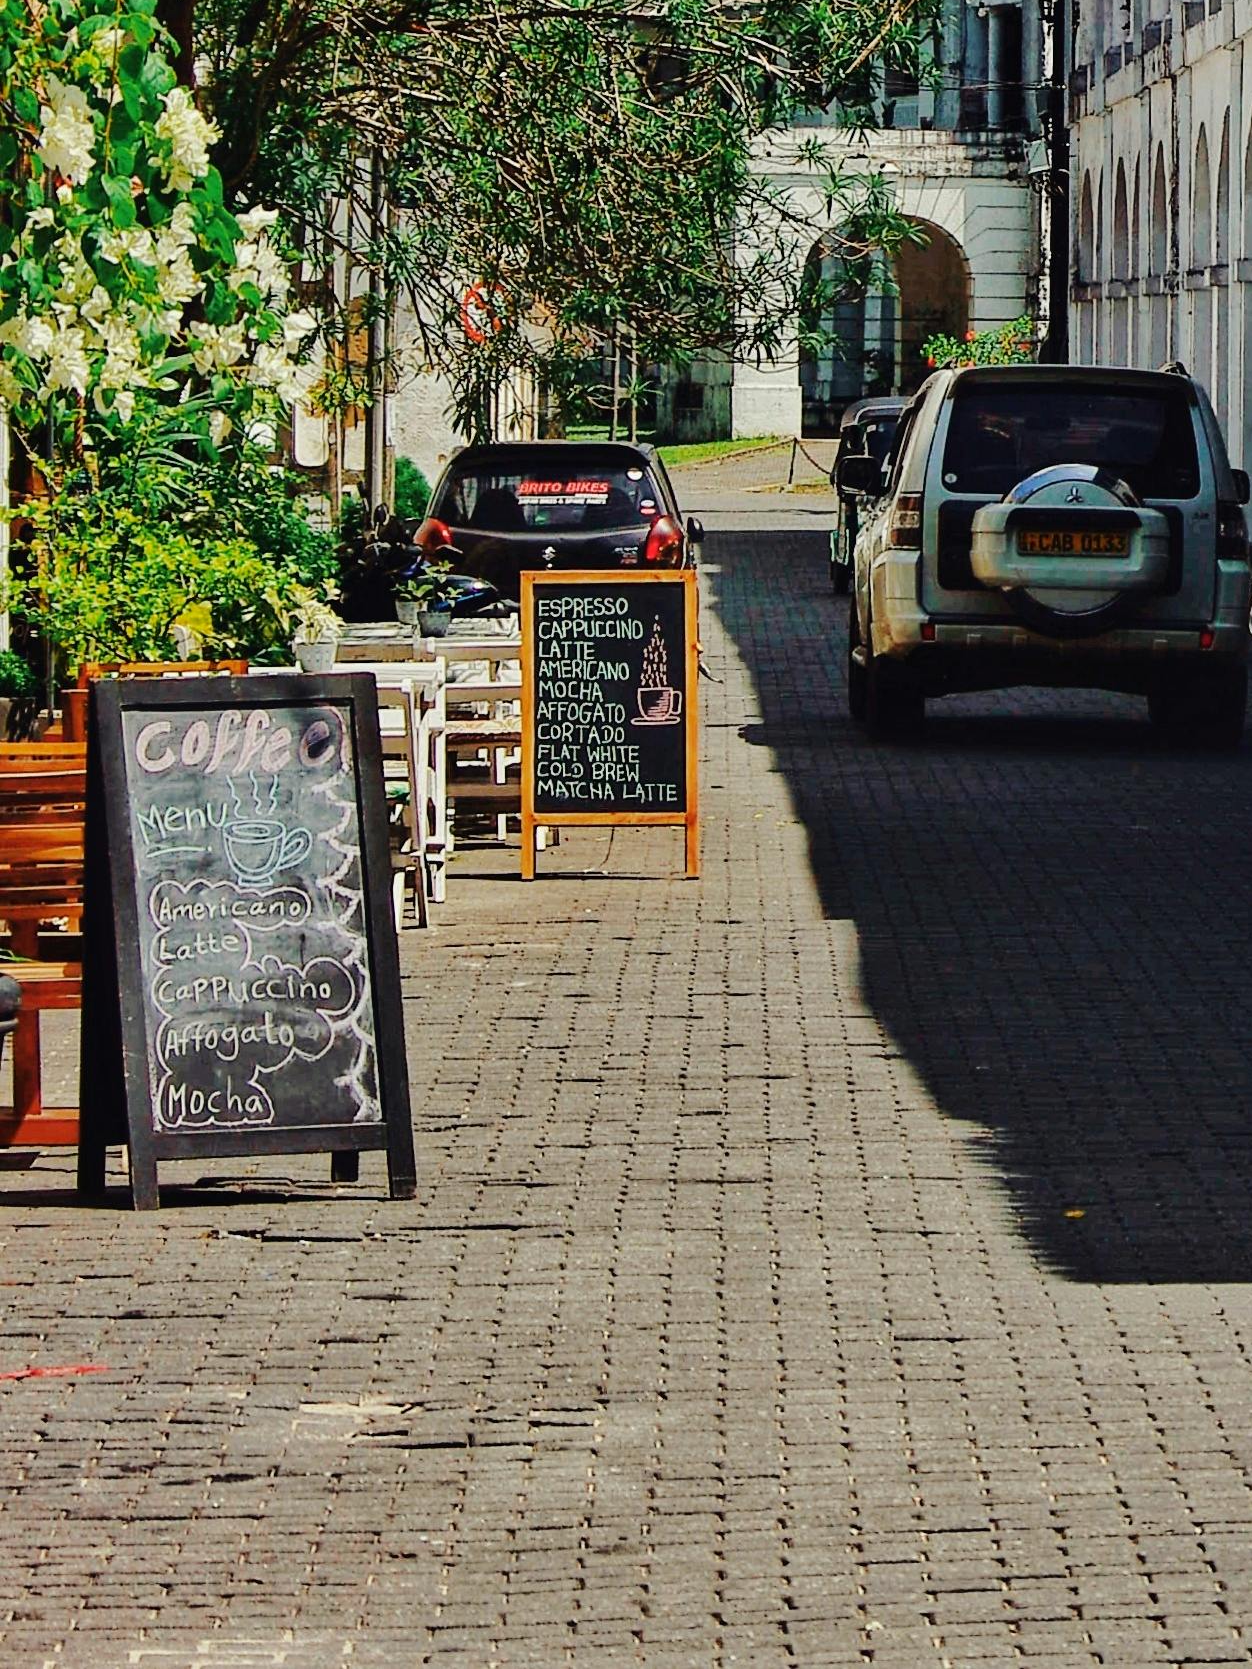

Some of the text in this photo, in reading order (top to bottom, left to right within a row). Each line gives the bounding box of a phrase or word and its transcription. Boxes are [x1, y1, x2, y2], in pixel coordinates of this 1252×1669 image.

[520, 482, 608, 493] BRITO BIKES
[1039, 533, 1072, 552] CAB
[538, 597, 629, 619] ESPRESSO
[538, 619, 644, 641] CAPPUCCINO
[539, 641, 595, 660] LATTE
[538, 660, 630, 681] AMERICANO
[539, 681, 604, 702] MOCHA
[537, 702, 626, 724] AFFOGATO
[136, 709, 336, 774] Coffee
[537, 723, 625, 744] CORTADO
[538, 745, 640, 764] FLAT WHITE
[537, 761, 640, 782] COLD BREW
[537, 780, 678, 803] MATCHA LATTE
[136, 802, 228, 845] Menu
[158, 896, 303, 922] Americano
[158, 932, 239, 963] Latte
[168, 1079, 264, 1116] Mocha
